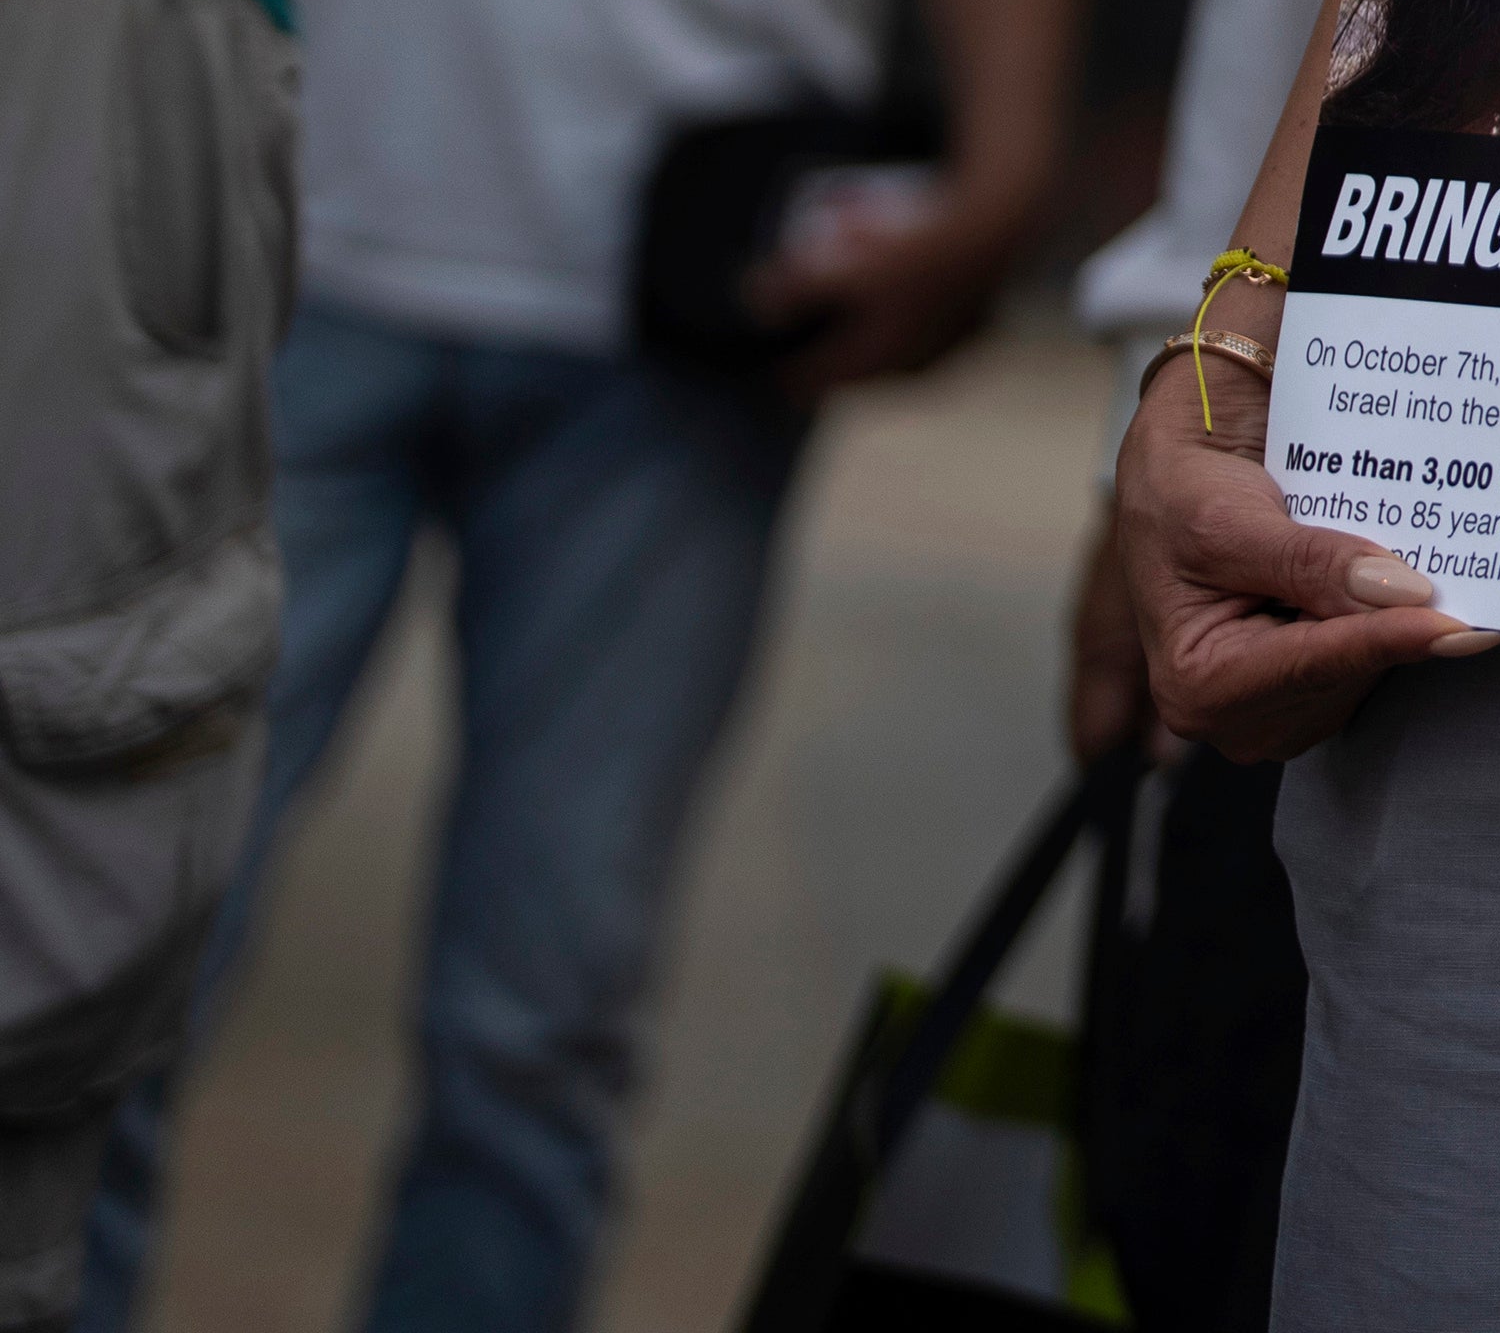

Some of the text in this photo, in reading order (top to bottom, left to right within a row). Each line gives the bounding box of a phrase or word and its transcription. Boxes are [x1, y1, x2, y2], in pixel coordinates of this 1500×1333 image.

[1306, 338, 1335, 368] On
[1344, 339, 1446, 378] October
[1456, 351, 1499, 385] 7th,
[1329, 384, 1397, 417] Israel
[1406, 392, 1452, 422] into
[1462, 397, 1499, 426] the
[1286, 443, 1343, 474] More
[1352, 449, 1413, 482] than
[1422, 458, 1493, 490] 3,000
[1284, 489, 1368, 521] months
[1378, 496, 1402, 524] to
[1410, 500, 1442, 529] 85
